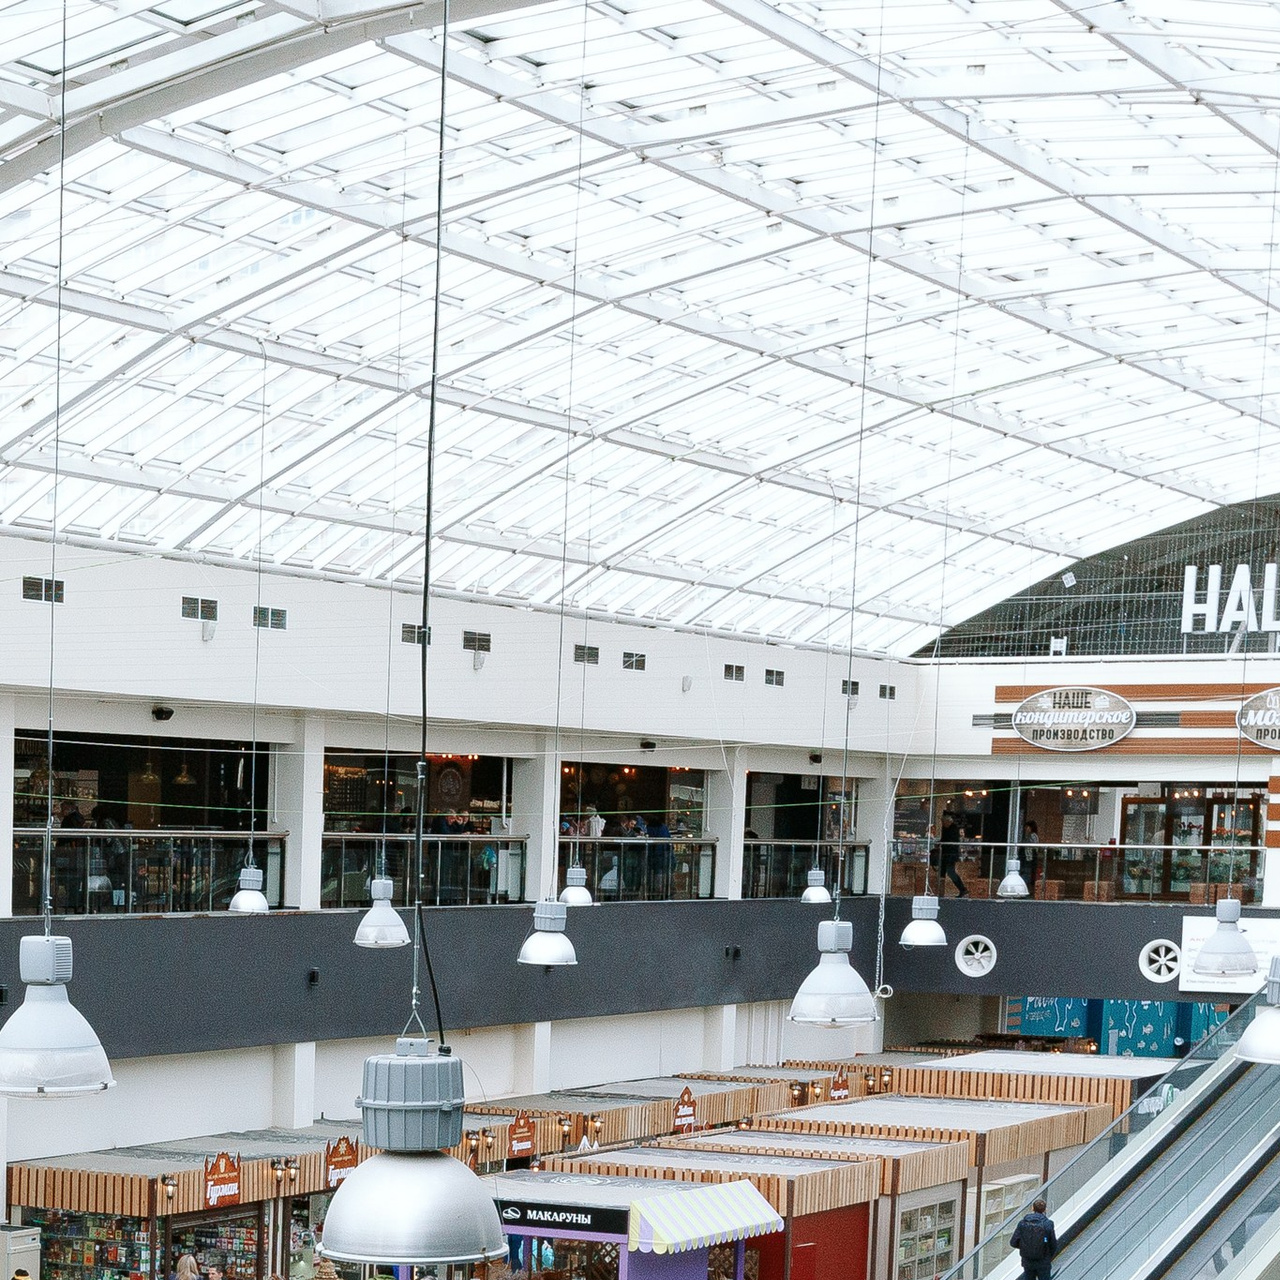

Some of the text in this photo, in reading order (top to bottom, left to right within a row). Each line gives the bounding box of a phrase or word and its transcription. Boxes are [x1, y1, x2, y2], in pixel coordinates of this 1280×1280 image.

[1052, 691, 1092, 709] НАШЕ
[1015, 710, 1131, 728] кондитерское
[1032, 729, 1115, 741] ПРОИЗВОДСТВО
[526, 1209, 591, 1225] МАКАРУНЫ
